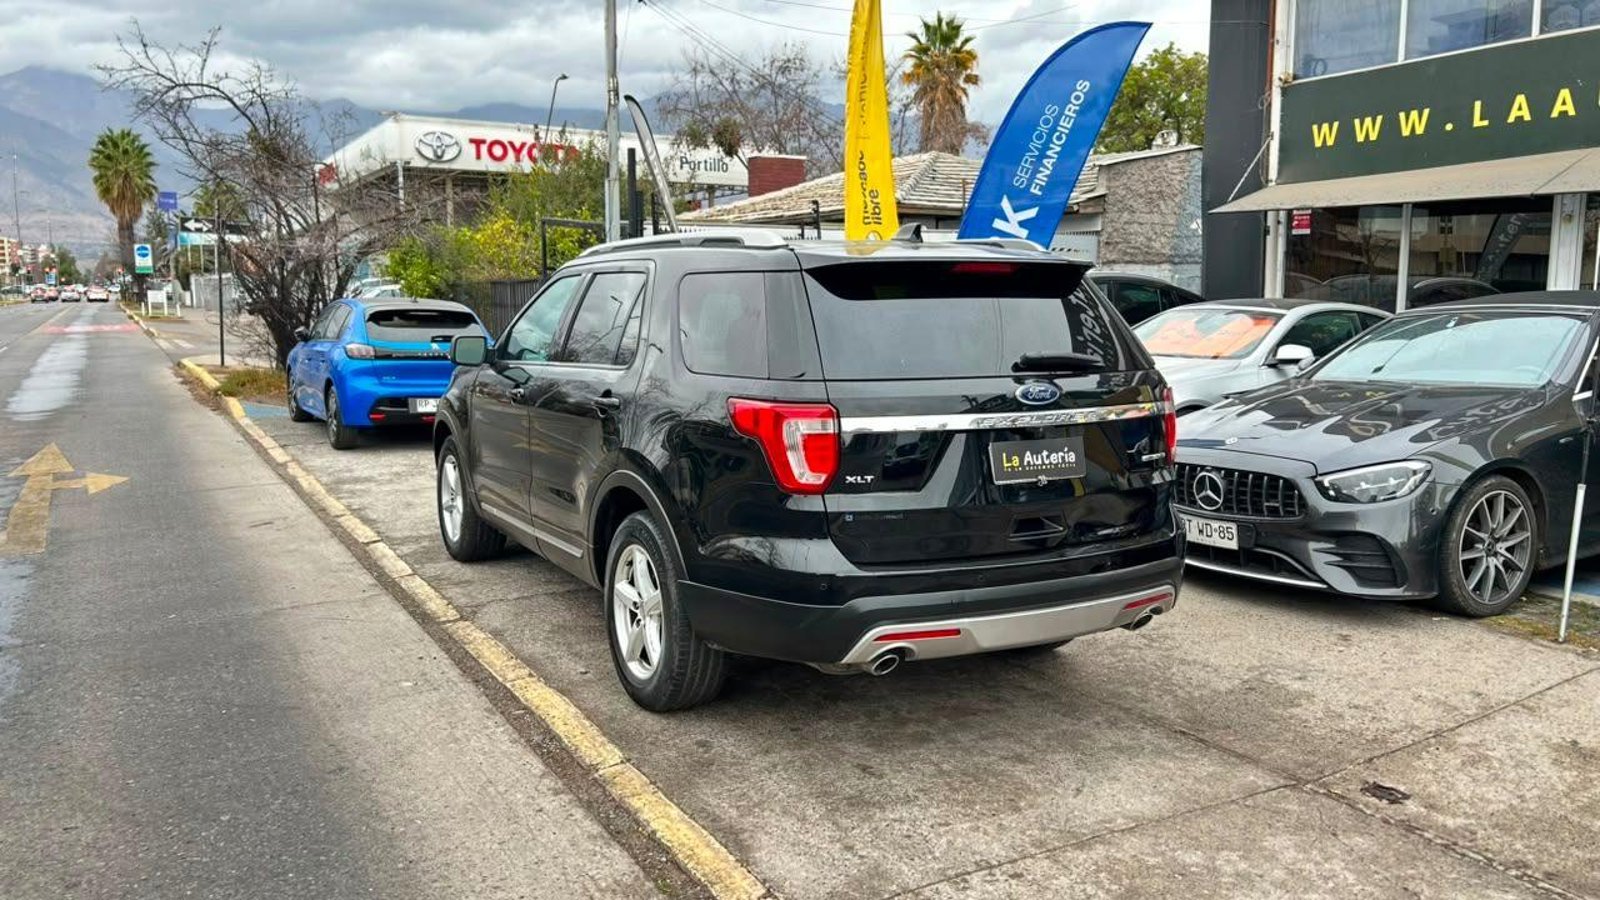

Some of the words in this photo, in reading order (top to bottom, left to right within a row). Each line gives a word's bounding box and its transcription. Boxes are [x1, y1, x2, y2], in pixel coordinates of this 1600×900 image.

[1312, 88, 1600, 147] WWW.LAA
[1014, 104, 1059, 189] SERVICIOS
[1031, 80, 1091, 196] FINANCIEROS
[680, 156, 729, 173] Portillo
[868, 189, 883, 226] libre
[992, 194, 1040, 239] K
[1028, 386, 1053, 400] Ford
[1002, 452, 1020, 468] La
[1024, 446, 1077, 467] Autería
[845, 475, 875, 484] XLT
